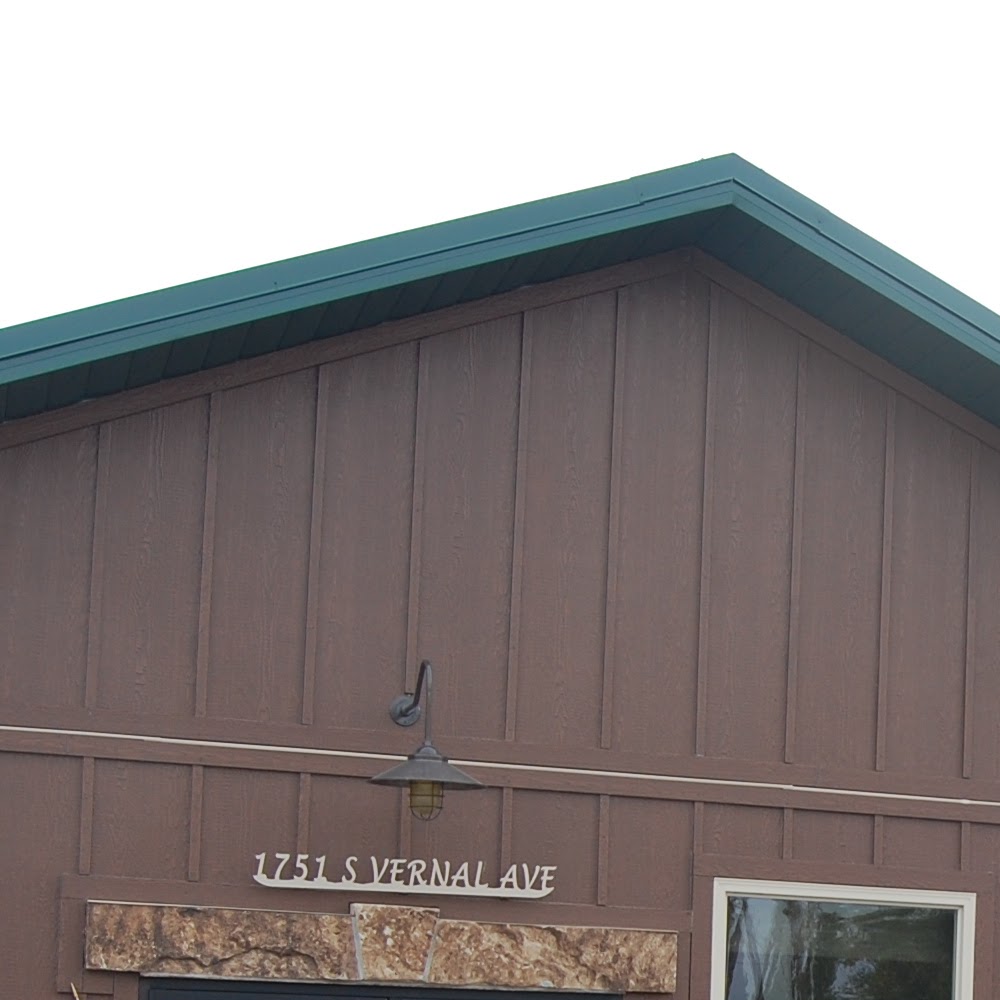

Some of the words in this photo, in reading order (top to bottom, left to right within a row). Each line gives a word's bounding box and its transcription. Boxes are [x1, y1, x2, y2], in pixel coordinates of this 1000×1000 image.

[253, 852, 327, 882] 1751
[341, 856, 358, 883] S
[370, 856, 489, 889] VERNAL
[499, 863, 558, 891] AVE
